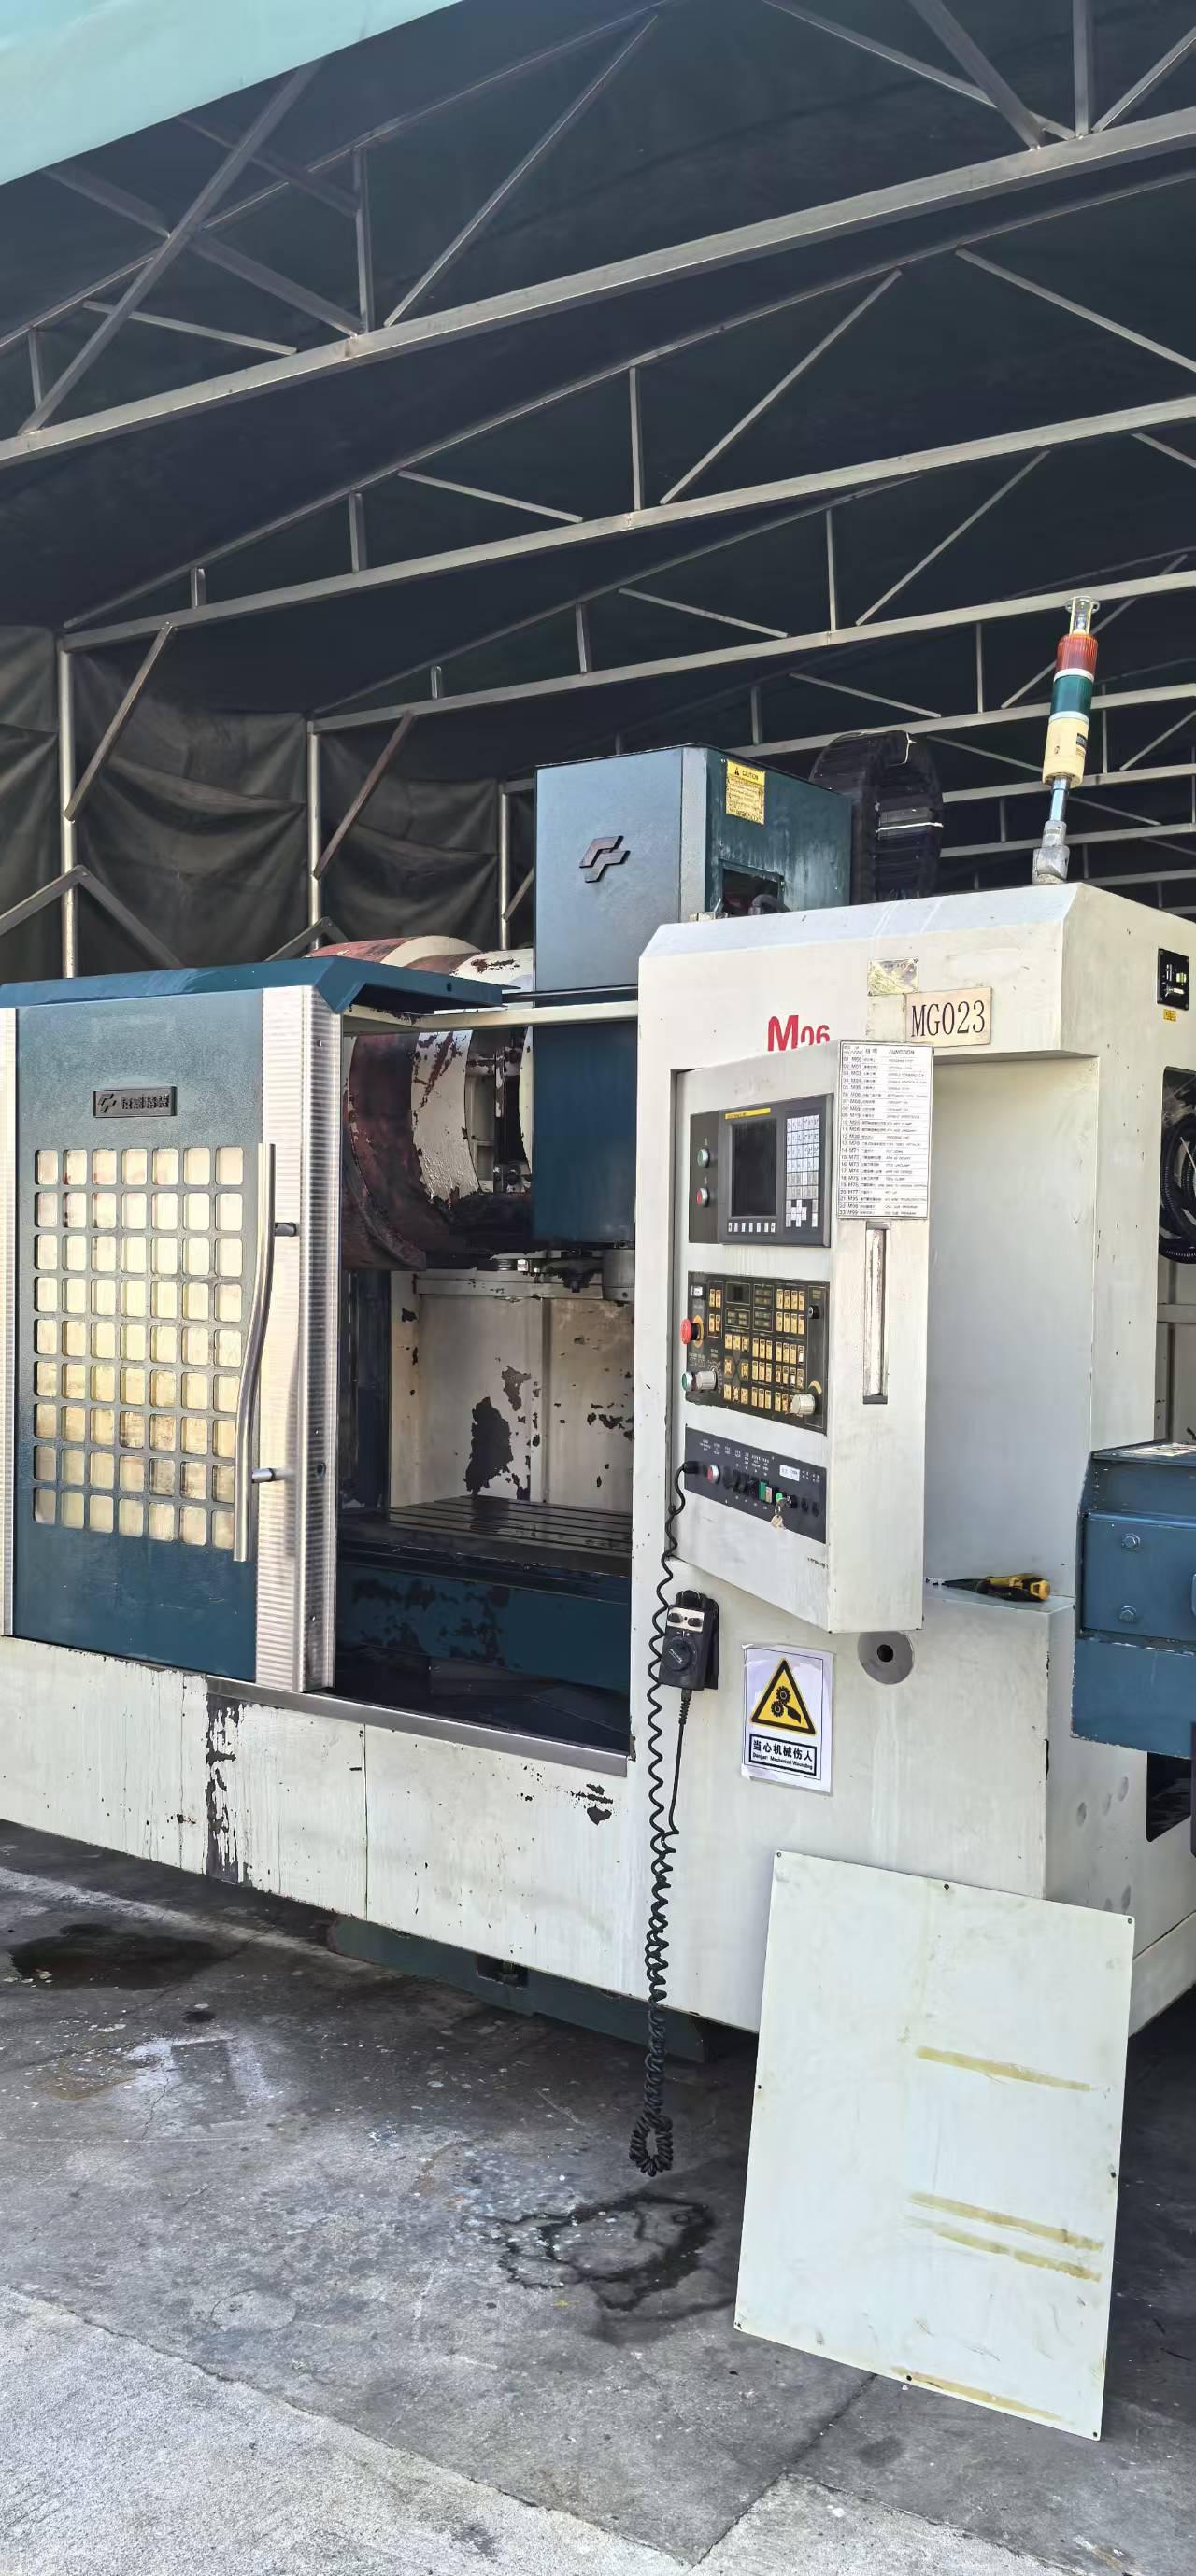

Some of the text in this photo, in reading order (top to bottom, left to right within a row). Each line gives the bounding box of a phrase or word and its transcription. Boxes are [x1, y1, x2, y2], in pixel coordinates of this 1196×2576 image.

[742, 771, 759, 780] CAUTION
[911, 1000, 986, 1037] MG023
[753, 1739, 813, 1762] 当心机械伤人
